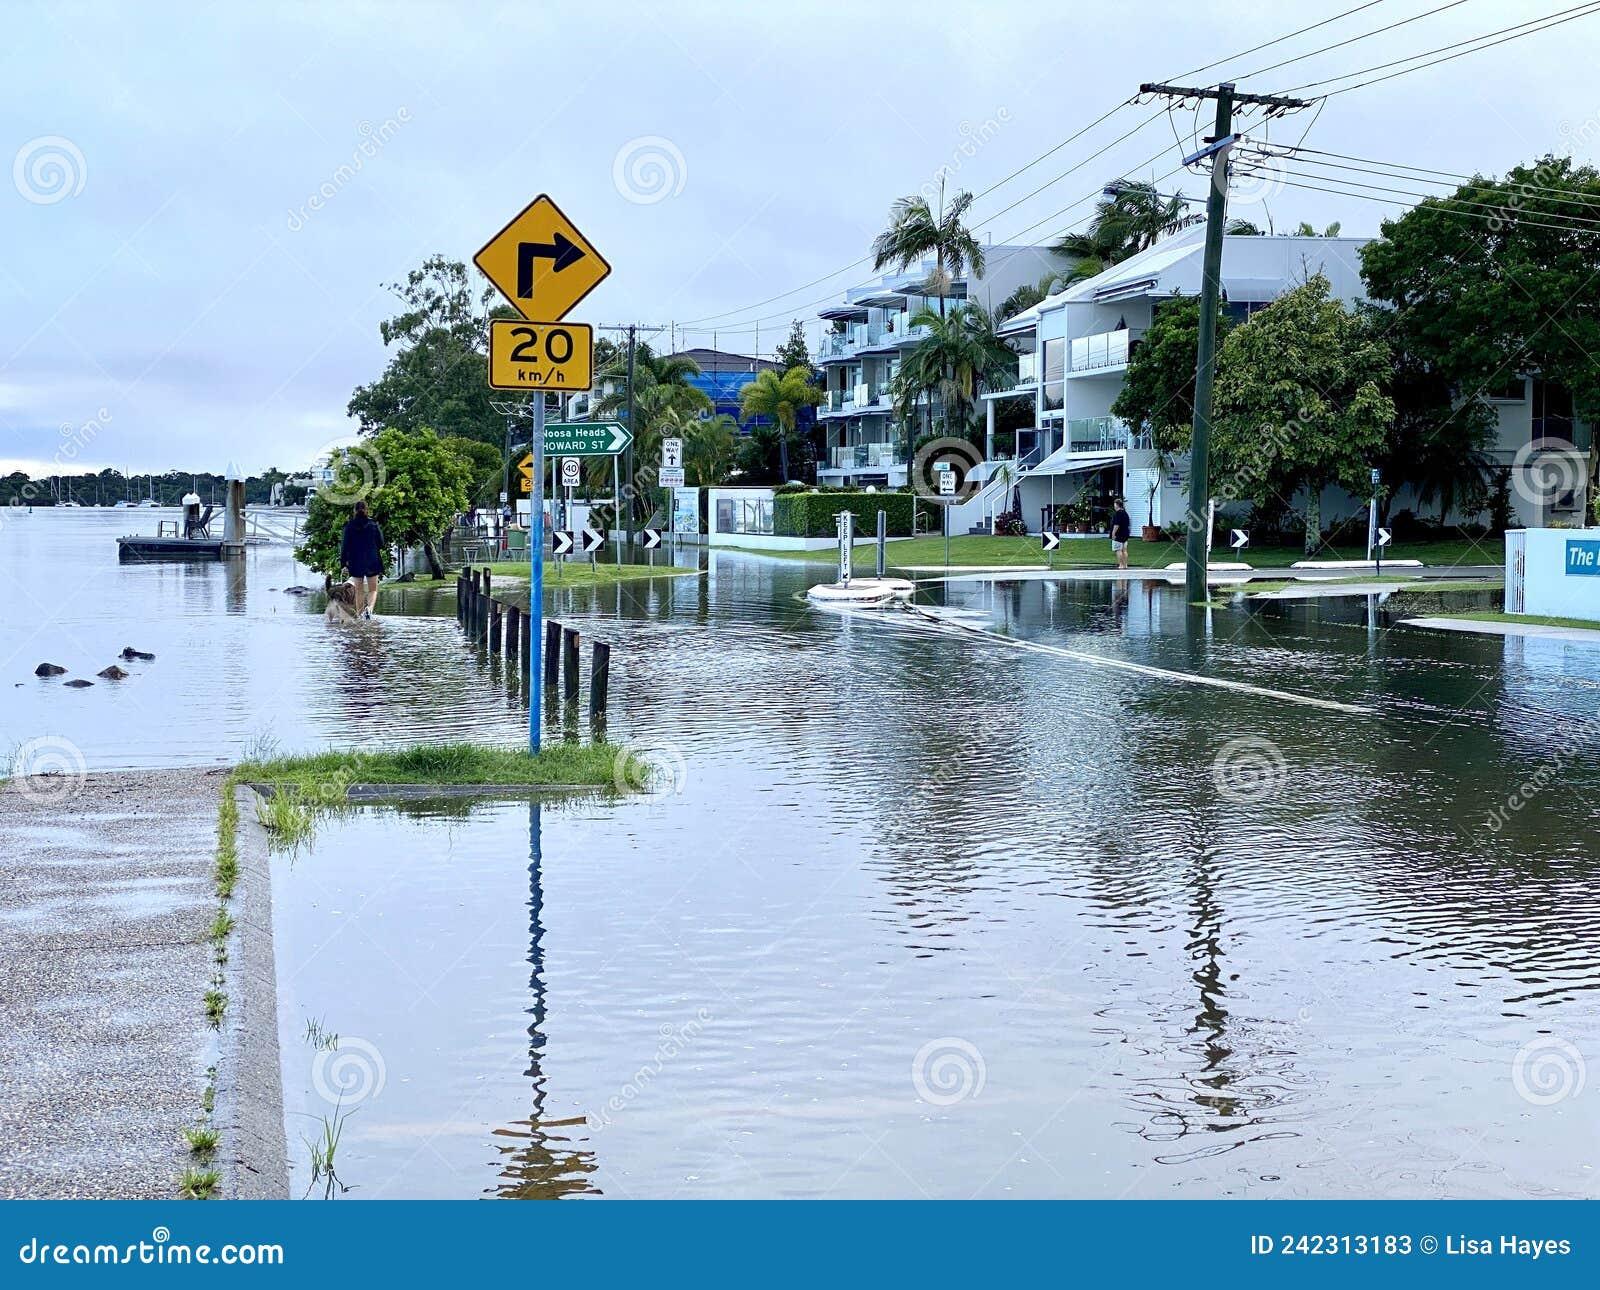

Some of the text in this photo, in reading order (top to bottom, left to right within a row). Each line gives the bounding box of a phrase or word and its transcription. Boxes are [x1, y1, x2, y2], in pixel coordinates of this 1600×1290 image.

[510, 327, 574, 365] 20
[518, 366, 565, 385] km/h
[575, 428, 606, 437] Heads
[591, 440, 605, 449] ST
[565, 464, 577, 473] 40
[1570, 547, 1594, 566] The
